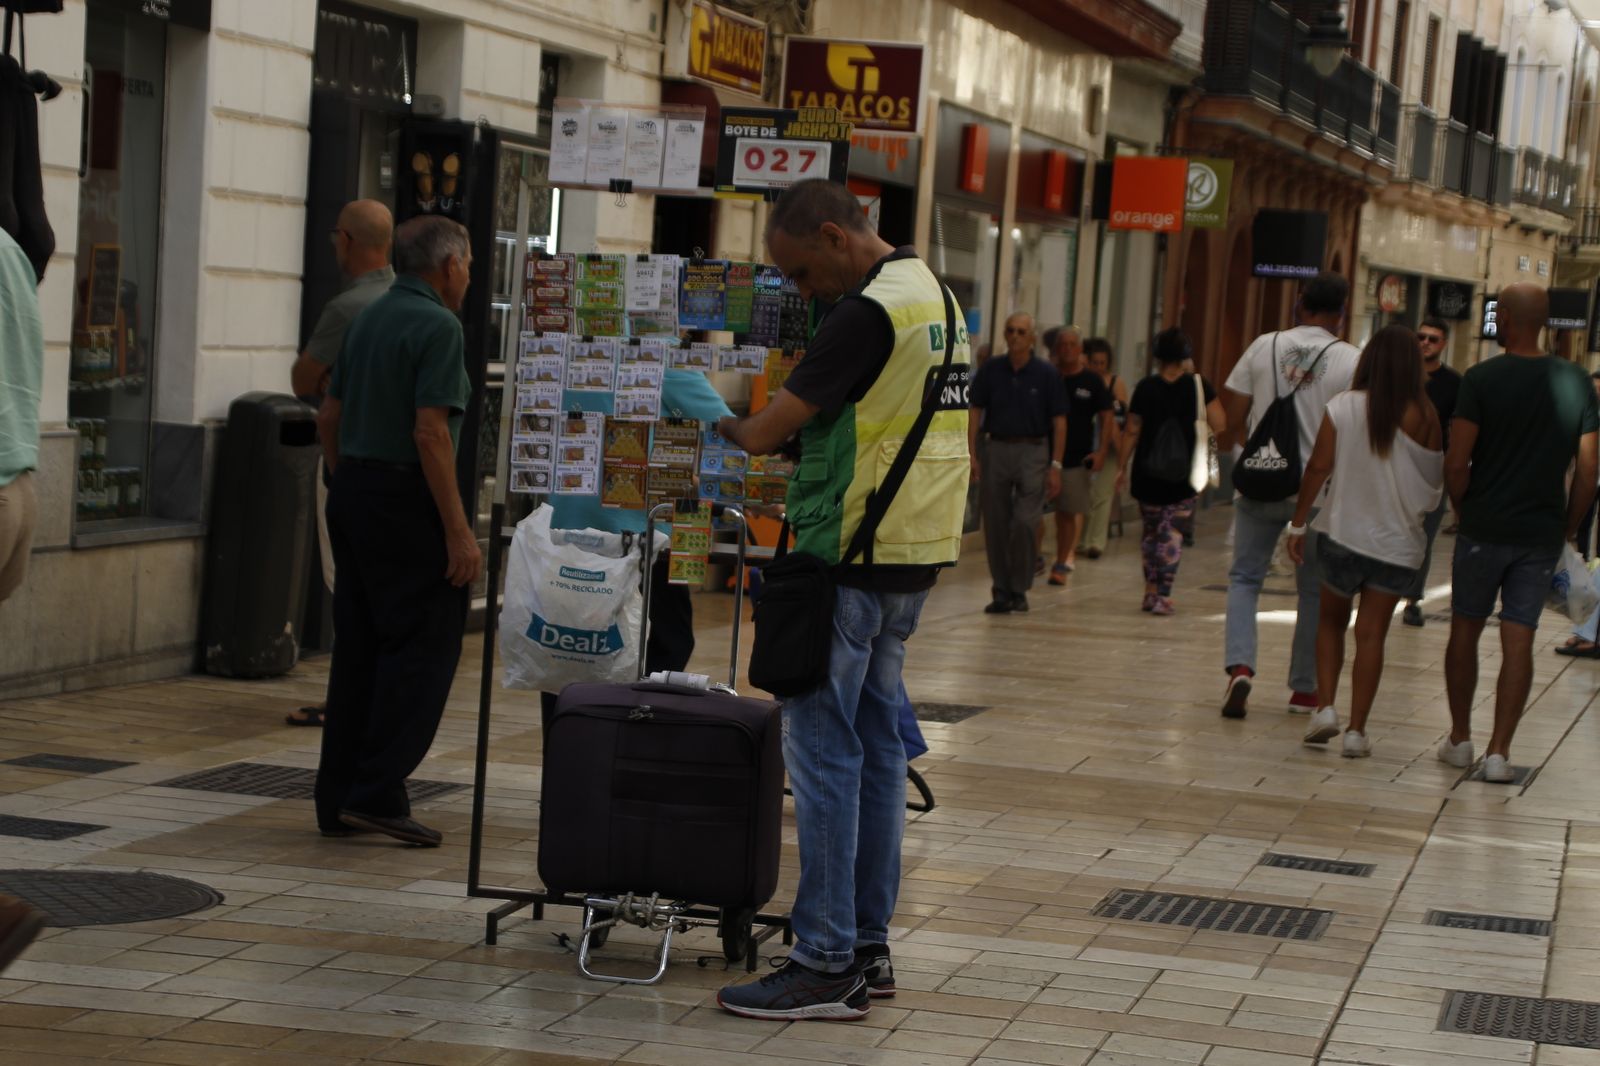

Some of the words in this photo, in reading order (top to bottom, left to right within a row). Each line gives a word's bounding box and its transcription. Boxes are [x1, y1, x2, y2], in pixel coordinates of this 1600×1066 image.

[713, 15, 764, 72] TABACOS
[790, 90, 912, 119] TABACOS
[725, 125, 758, 137] BOTE
[760, 127, 777, 137] DE
[1113, 210, 1175, 229] orange
[1244, 456, 1288, 469] adidas
[556, 581, 571, 591] 70%
[572, 584, 613, 595] RECICLADO
